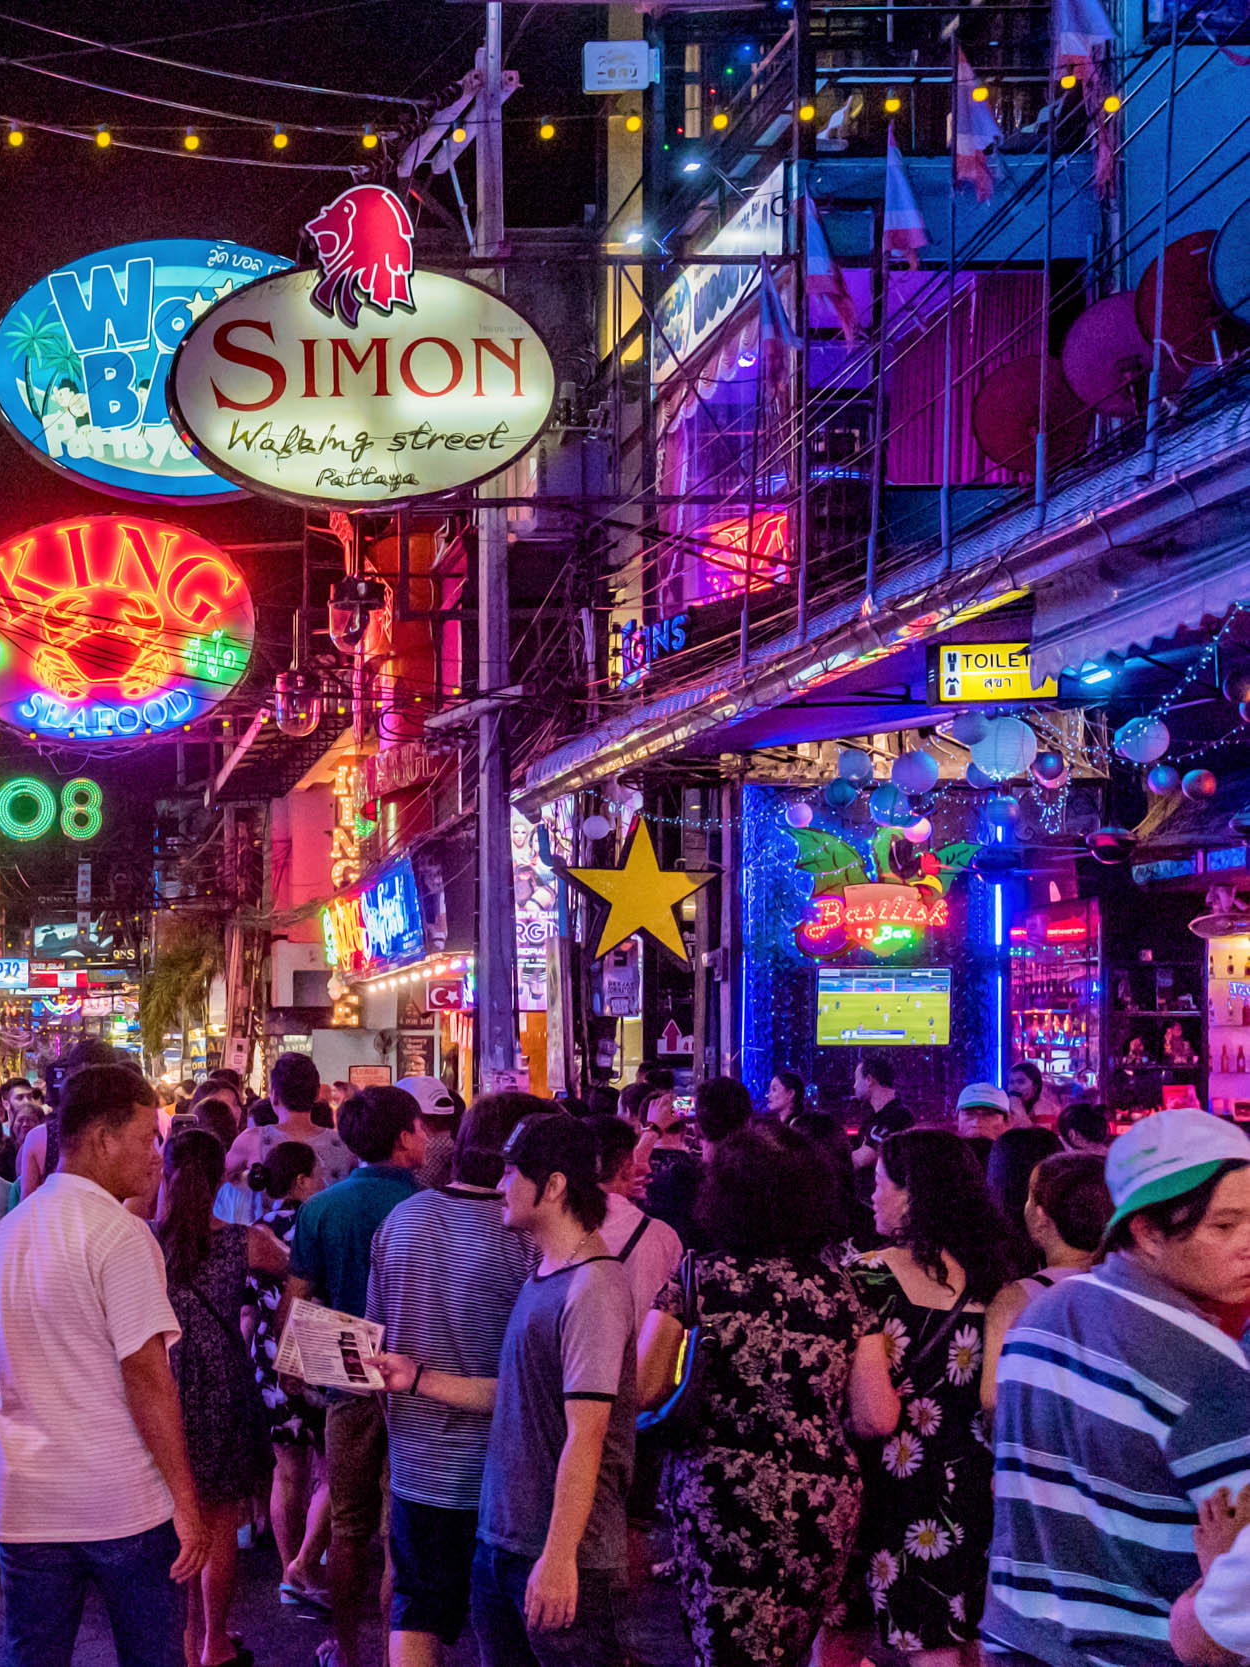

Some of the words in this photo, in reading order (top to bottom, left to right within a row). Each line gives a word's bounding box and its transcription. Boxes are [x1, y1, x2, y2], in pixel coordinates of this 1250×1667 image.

[209, 319, 525, 411] SIMON
[228, 419, 374, 463] Walking
[316, 466, 421, 492] Pattaya
[21, 688, 193, 735] SEAFOOD
[805, 896, 948, 938] Basilisk
[856, 927, 874, 939] 13
[873, 925, 912, 944] Bar
